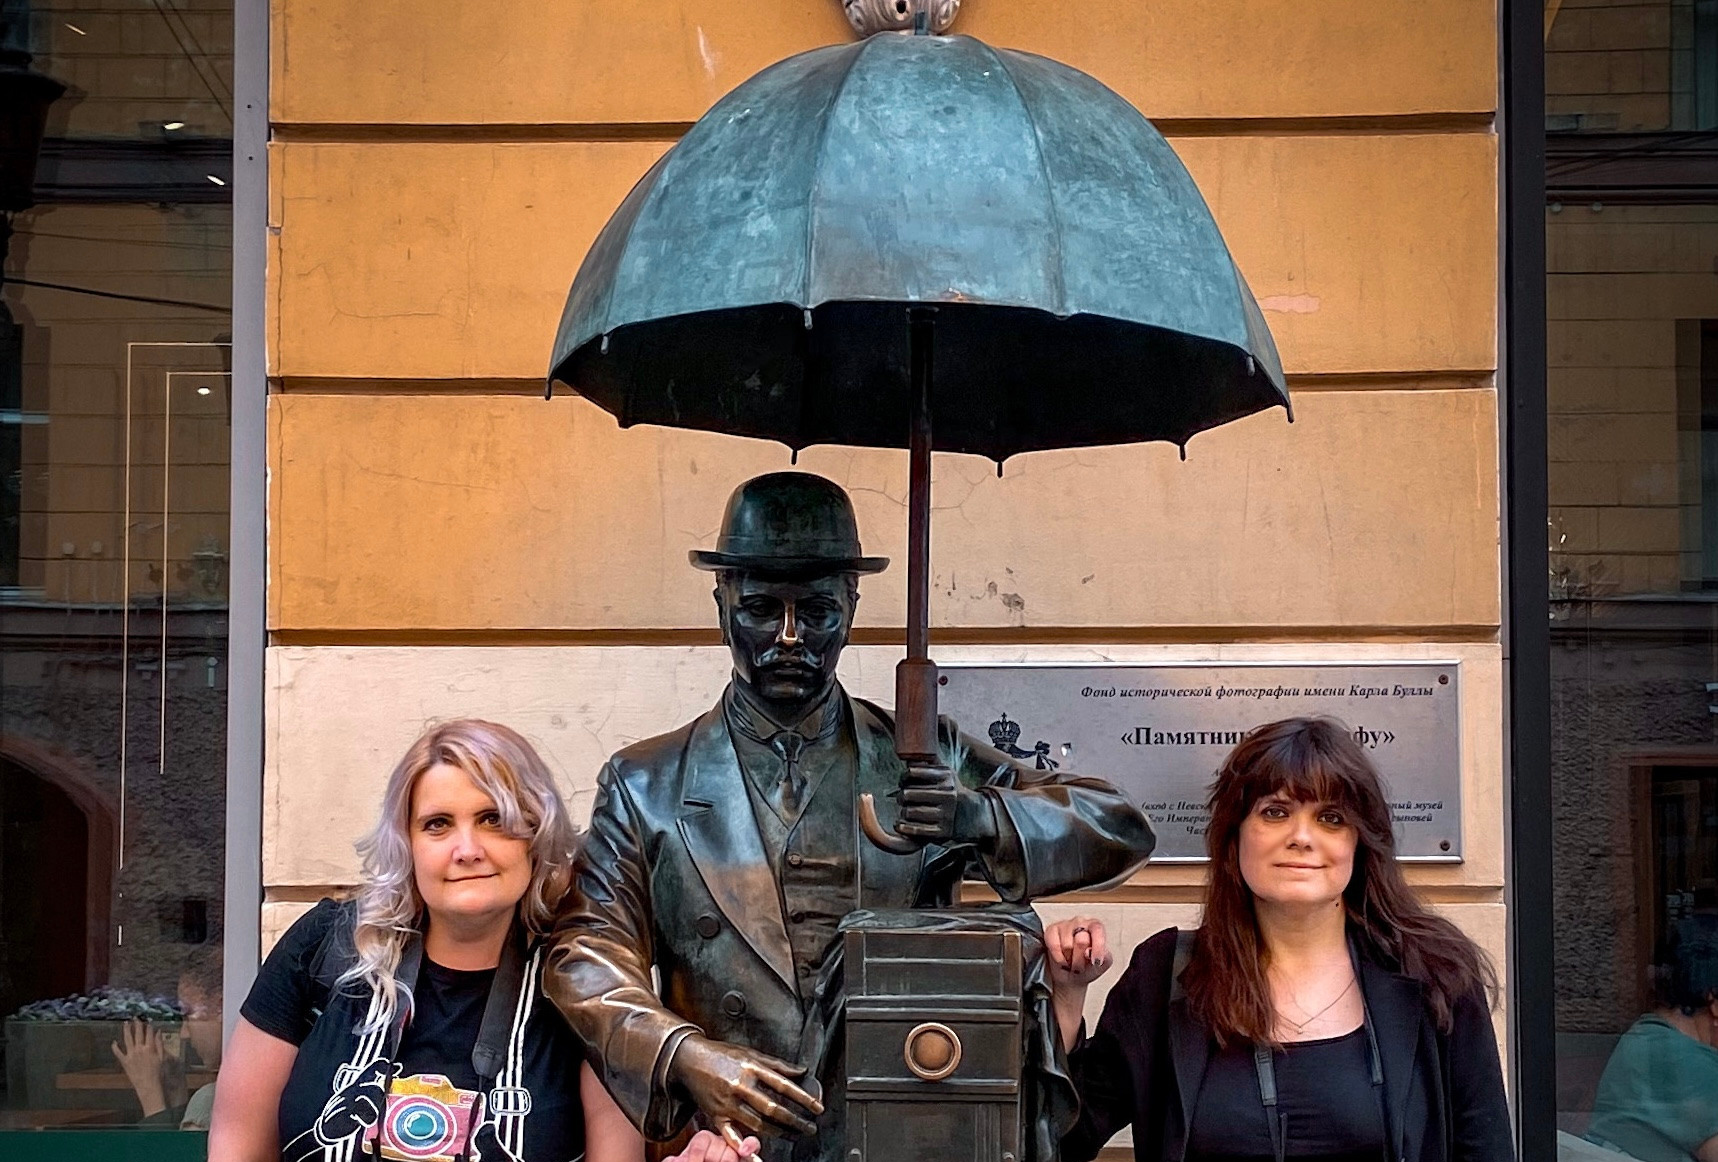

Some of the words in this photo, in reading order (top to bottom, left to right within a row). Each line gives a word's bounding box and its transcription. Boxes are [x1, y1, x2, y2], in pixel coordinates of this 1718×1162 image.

[1081, 686, 1116, 698] Фонд
[1120, 685, 1212, 699] исторической
[1215, 685, 1300, 699] фотографии
[1304, 686, 1345, 697] имени
[1348, 684, 1388, 699] Карла
[1392, 684, 1433, 699] Буллы
[1413, 800, 1443, 811] музей
[1186, 825, 1206, 835] Час
